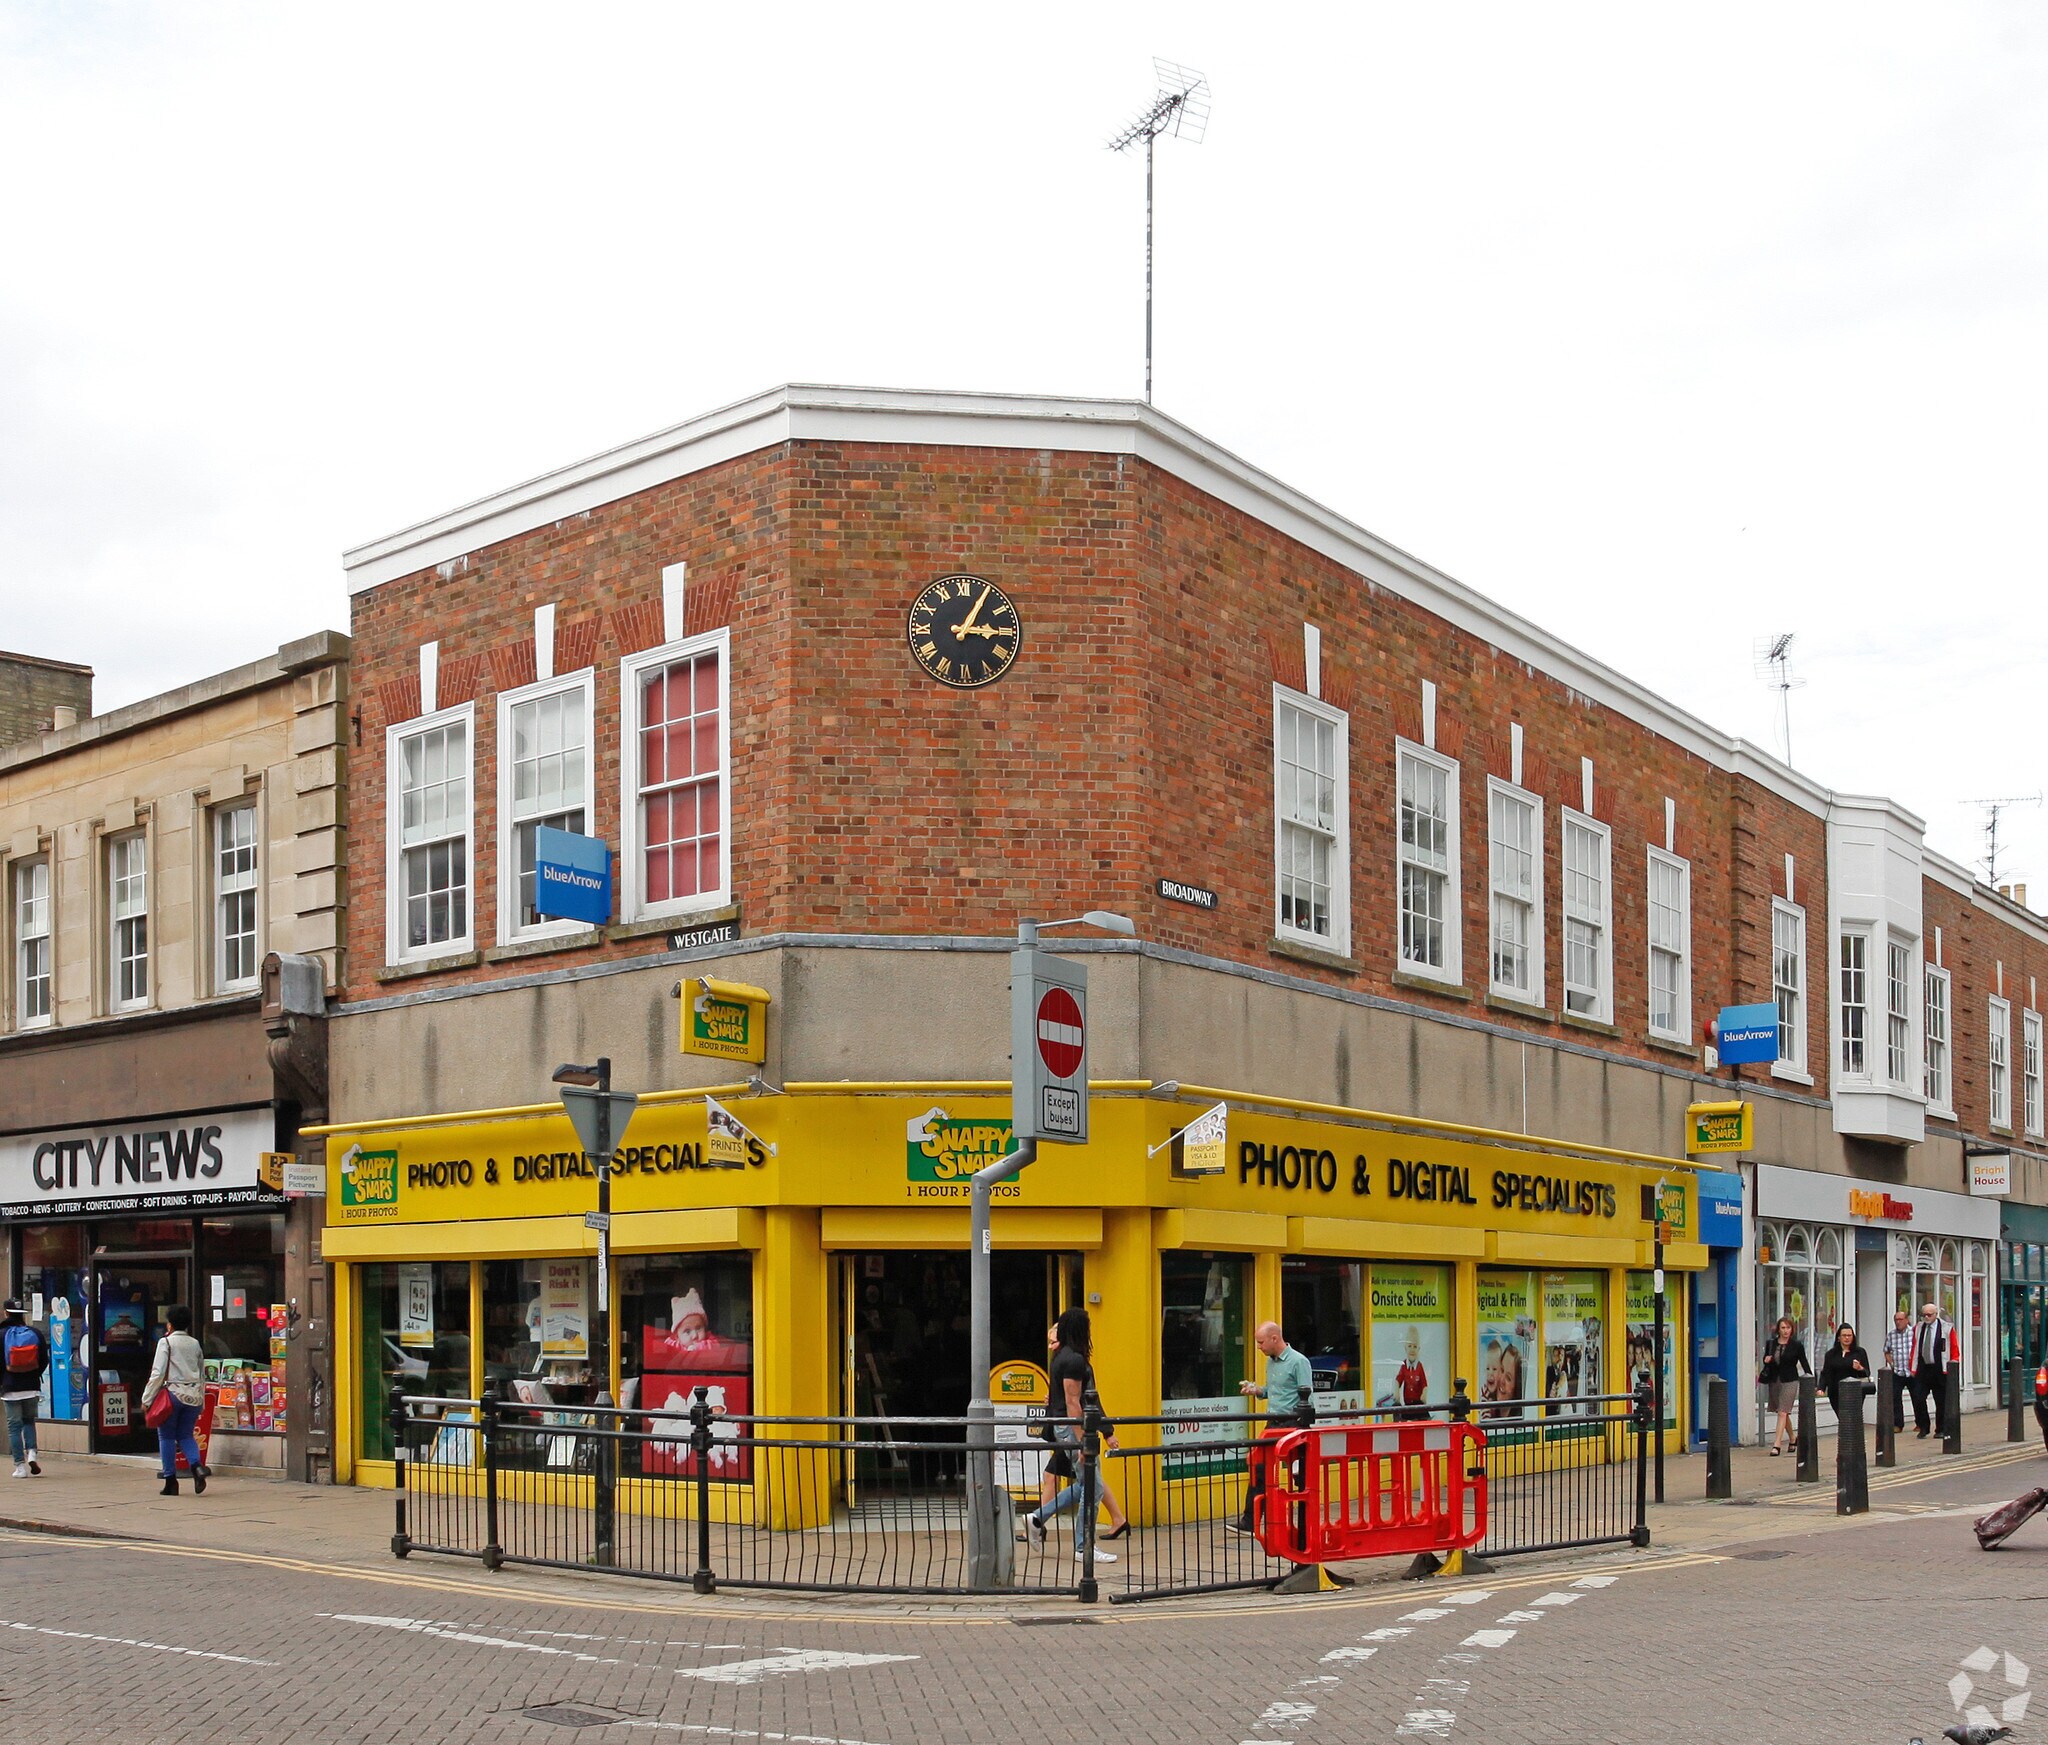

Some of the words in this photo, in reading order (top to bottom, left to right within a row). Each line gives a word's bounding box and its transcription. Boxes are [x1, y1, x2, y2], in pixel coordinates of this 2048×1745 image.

[935, 586, 951, 604] XI
[956, 582, 971, 597] XII
[920, 602, 937, 616] X
[992, 605, 1008, 616] II
[915, 622, 931, 635] IX
[998, 627, 1013, 636] III
[960, 664, 971, 679] VI
[981, 660, 993, 675] V
[544, 865, 602, 890] blueArrow
[1162, 880, 1212, 906] BROADWAY
[674, 926, 732, 949] WESTGATE
[701, 1001, 746, 1026] SNAPPY
[707, 1022, 744, 1042] SNAPS
[1724, 1030, 1774, 1043] blueArrow
[698, 1041, 720, 1050] HOUR
[720, 1044, 749, 1055] PHOTOS
[1048, 1094, 1075, 1110] Except
[1050, 1110, 1073, 1125] buses
[1703, 1114, 1739, 1130] SNAPPY
[920, 1122, 1012, 1158] SNAPPY
[1708, 1128, 1738, 1141] SNAPS
[710, 1138, 742, 1153] PRINTS
[33, 1136, 109, 1190] CITY
[115, 1125, 223, 1184] NEWS
[407, 1159, 472, 1188] PHOTO
[484, 1158, 499, 1183] &
[513, 1152, 594, 1182] DIGITAL
[609, 1138, 765, 1175] SPECIALS
[270, 1168, 281, 1176] Pay
[348, 1154, 395, 1186] SNAPPY
[933, 1152, 1007, 1180] SNAP
[1974, 1165, 2004, 1175] Bright
[288, 1173, 318, 1181] Passport
[1240, 1141, 1338, 1192] PHOTO
[1353, 1154, 1371, 1195] &
[1388, 1158, 1477, 1205] DIGITAL
[1492, 1170, 1616, 1218] SPECIALISTS
[1974, 1177, 2005, 1185] House
[354, 1178, 393, 1204] SNAPS
[907, 1186, 911, 1197] 1
[918, 1186, 958, 1197] HOUR
[962, 1186, 1020, 1197] PTOS
[1658, 1187, 1684, 1209] SNAPPY
[1, 1205, 29, 1216] TOBACCO
[32, 1204, 51, 1214] NEWS
[54, 1202, 82, 1213] LOTTERY
[86, 1198, 139, 1211] CONFECTIONERY
[143, 1196, 160, 1207] SOFT
[161, 1195, 187, 1206] DRINKS
[192, 1192, 223, 1205] TOP-UPS
[341, 1210, 345, 1219] 1
[346, 1208, 367, 1218] HOUR
[368, 1207, 399, 1217] PHOTOS
[1662, 1206, 1683, 1225] SNAPS
[549, 1264, 580, 1277] Don't
[549, 1279, 569, 1289] Risk
[1372, 1290, 1404, 1306] Onsite
[1406, 1291, 1437, 1306] Studio
[1501, 1293, 1507, 1307] &
[1510, 1293, 1527, 1307] Film
[1544, 1293, 1568, 1307] Mobile
[1571, 1293, 1596, 1308] Phones
[106, 1407, 124, 1415] SALE
[1029, 1409, 1046, 1417] DID
[1194, 1405, 1210, 1413] home
[1211, 1404, 1229, 1412] videos
[105, 1417, 125, 1425] HERE
[1178, 1422, 1200, 1434] DVD
